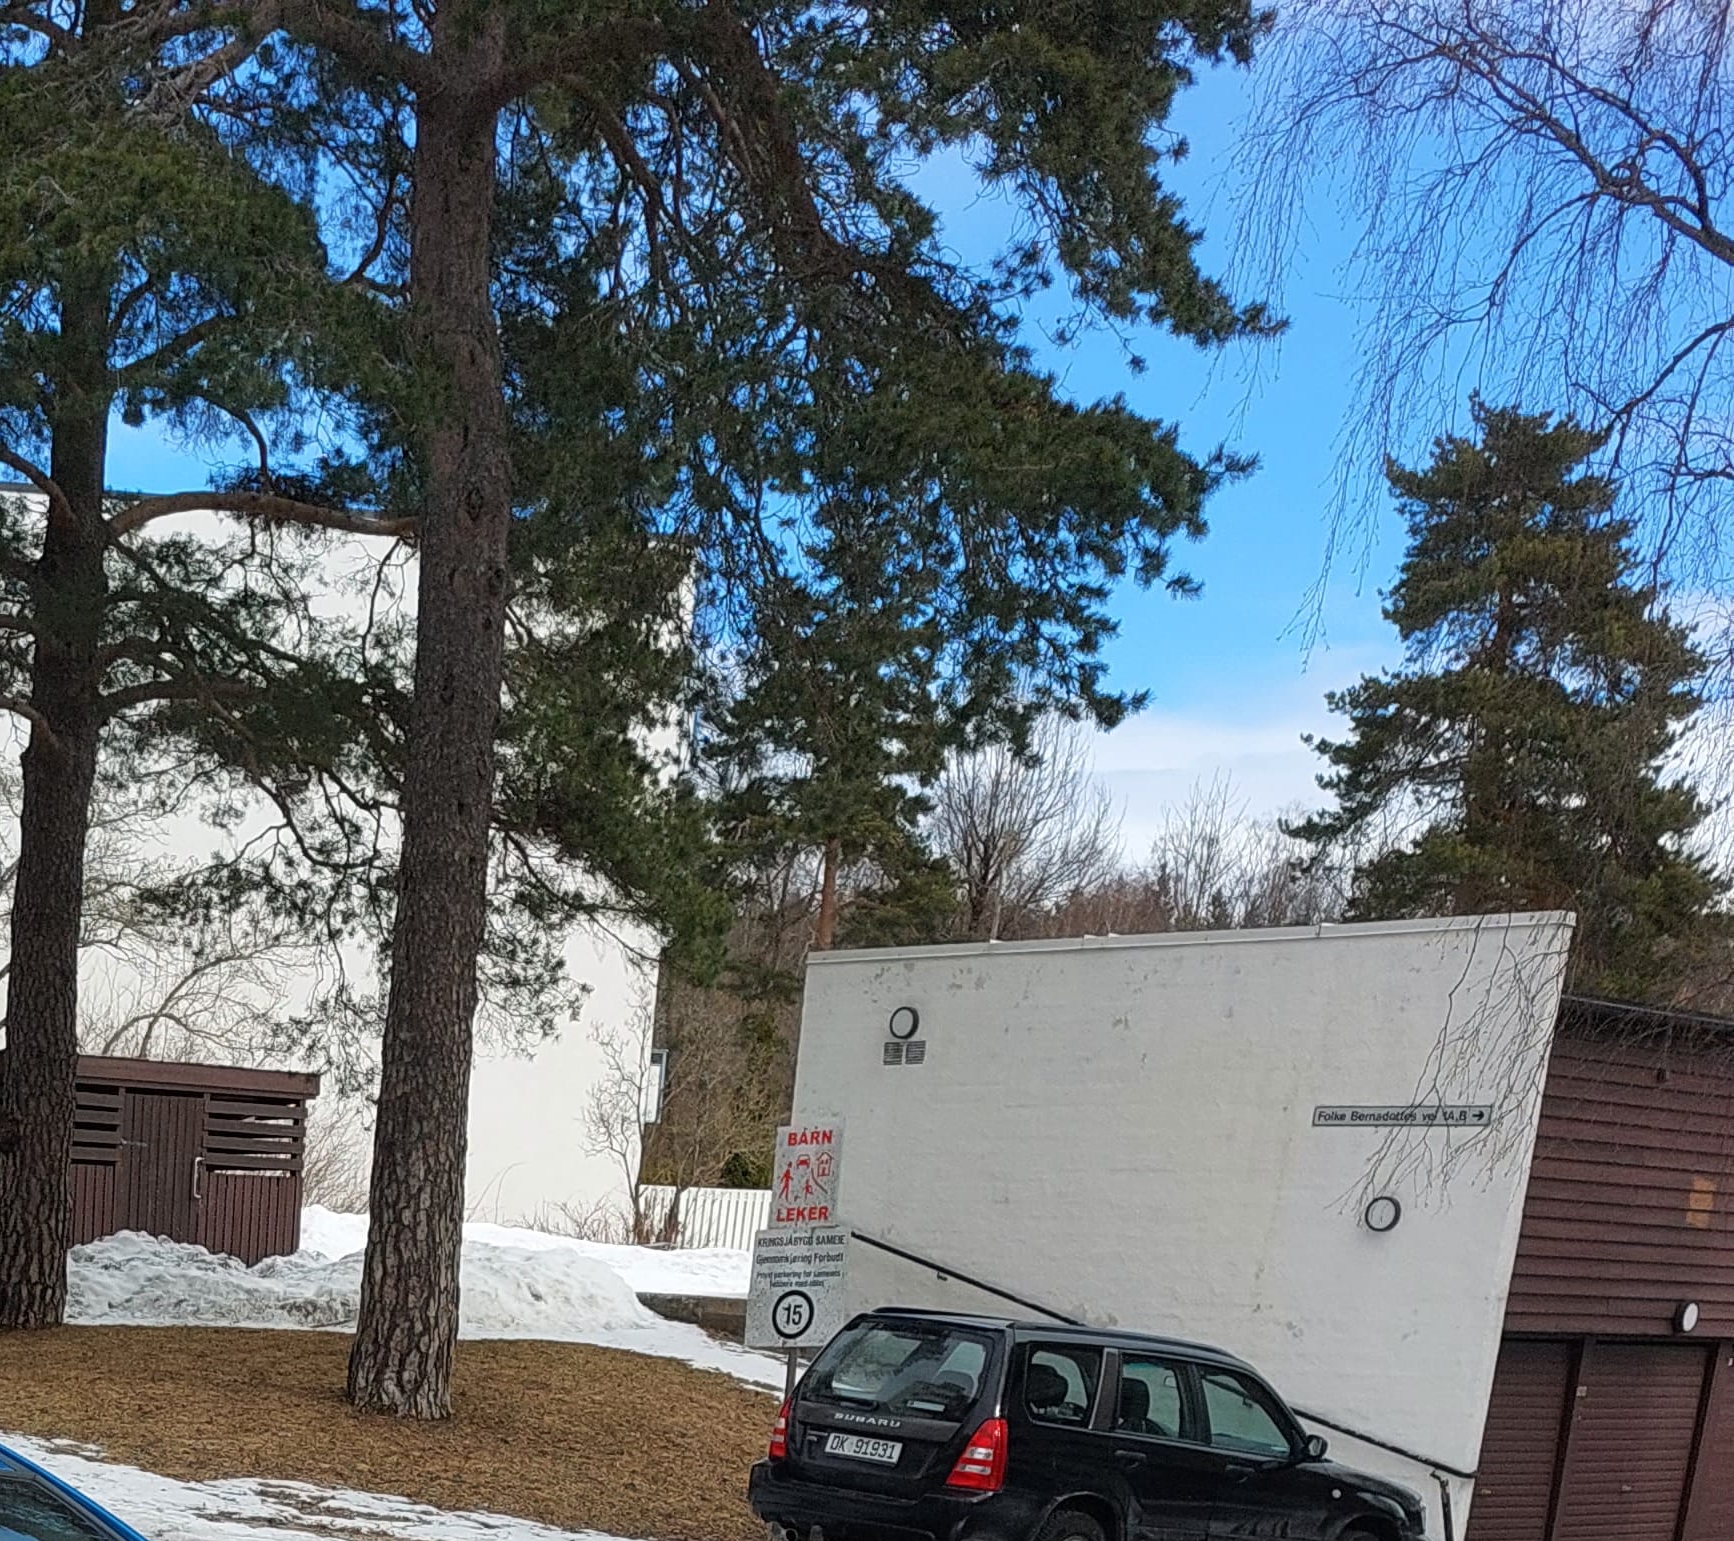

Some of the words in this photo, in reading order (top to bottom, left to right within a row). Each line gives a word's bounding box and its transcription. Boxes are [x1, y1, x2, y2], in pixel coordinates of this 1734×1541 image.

[1317, 1111, 1347, 1122] Folke
[1350, 1110, 1417, 1122] Bernadottes
[787, 1130, 833, 1147] BARN
[775, 1205, 829, 1222] LEKER
[815, 1234, 845, 1246] SAMEIE
[782, 1302, 803, 1326] 15
[834, 1412, 901, 1428] SUBARU
[830, 1435, 848, 1453] DK
[853, 1438, 896, 1460] 91931
